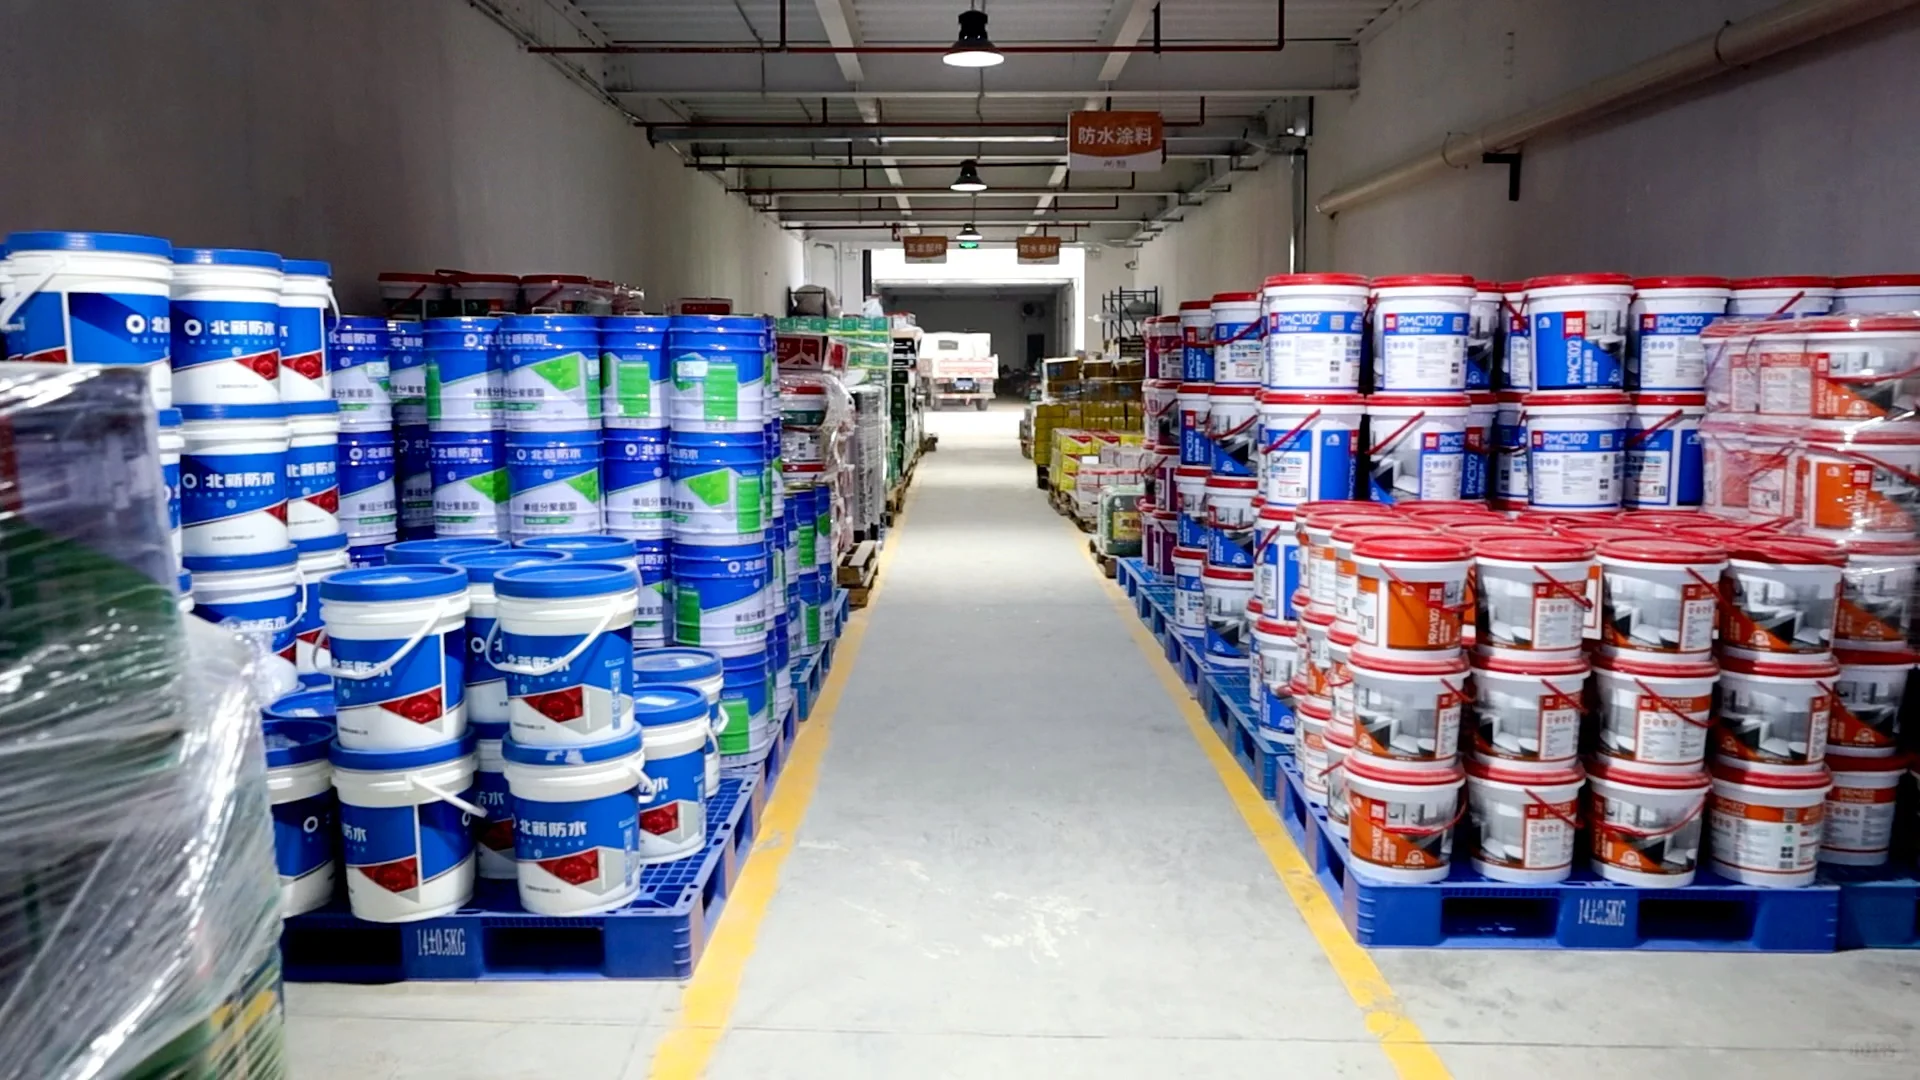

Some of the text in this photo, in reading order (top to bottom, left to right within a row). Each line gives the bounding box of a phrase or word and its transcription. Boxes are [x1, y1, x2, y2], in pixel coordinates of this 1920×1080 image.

[1077, 126, 1153, 146] 防水涂料
[210, 319, 276, 336] 北新防水
[1277, 313, 1320, 326] PMC102
[1397, 315, 1443, 327] PMC102
[1656, 315, 1704, 328] PMC102
[1567, 340, 1582, 384] PMC102
[1542, 432, 1589, 445] PMC102
[531, 448, 582, 461] 北新防水
[205, 472, 276, 489] 北新防水
[519, 818, 587, 838] 北新防水
[416, 927, 466, 956] 14±0.5KG
